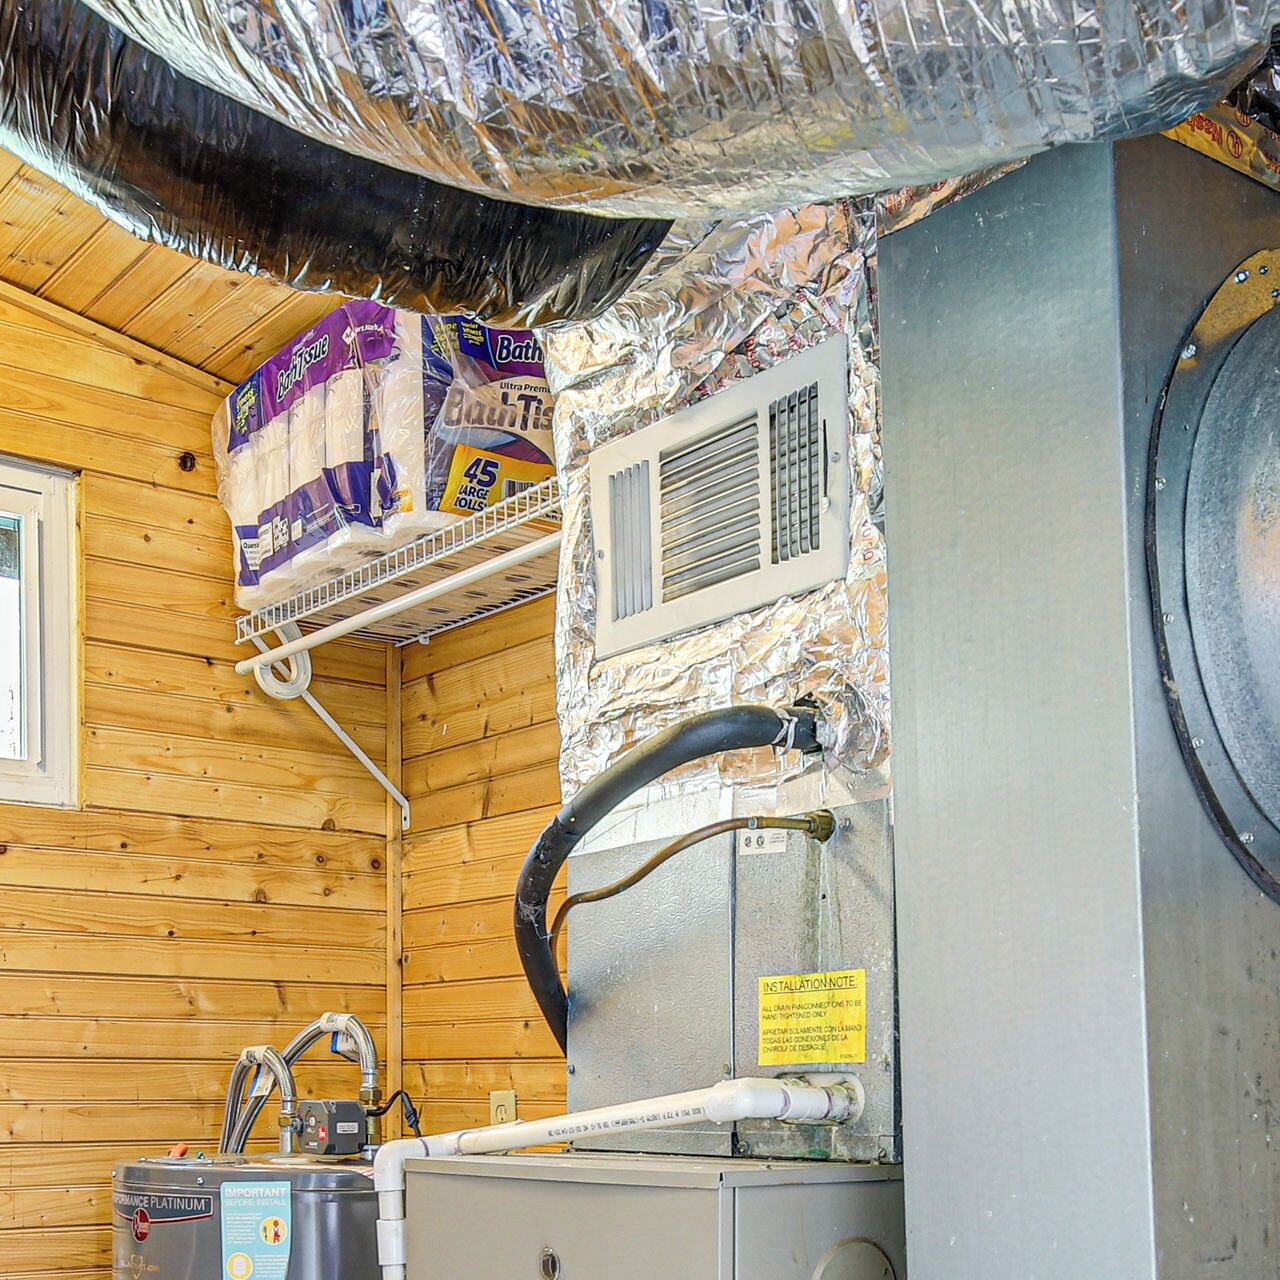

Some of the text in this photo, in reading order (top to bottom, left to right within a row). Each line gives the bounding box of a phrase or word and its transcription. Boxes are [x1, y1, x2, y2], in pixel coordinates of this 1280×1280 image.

[1186, 114, 1222, 145] Nash
[499, 381, 551, 393] Ultra Prem
[518, 393, 554, 431] Tis
[463, 456, 500, 488] 45
[763, 975, 855, 992] INSTALLATION NOTE
[225, 1188, 287, 1198] IMPORTANT
[150, 1196, 206, 1211] PLATINUM
